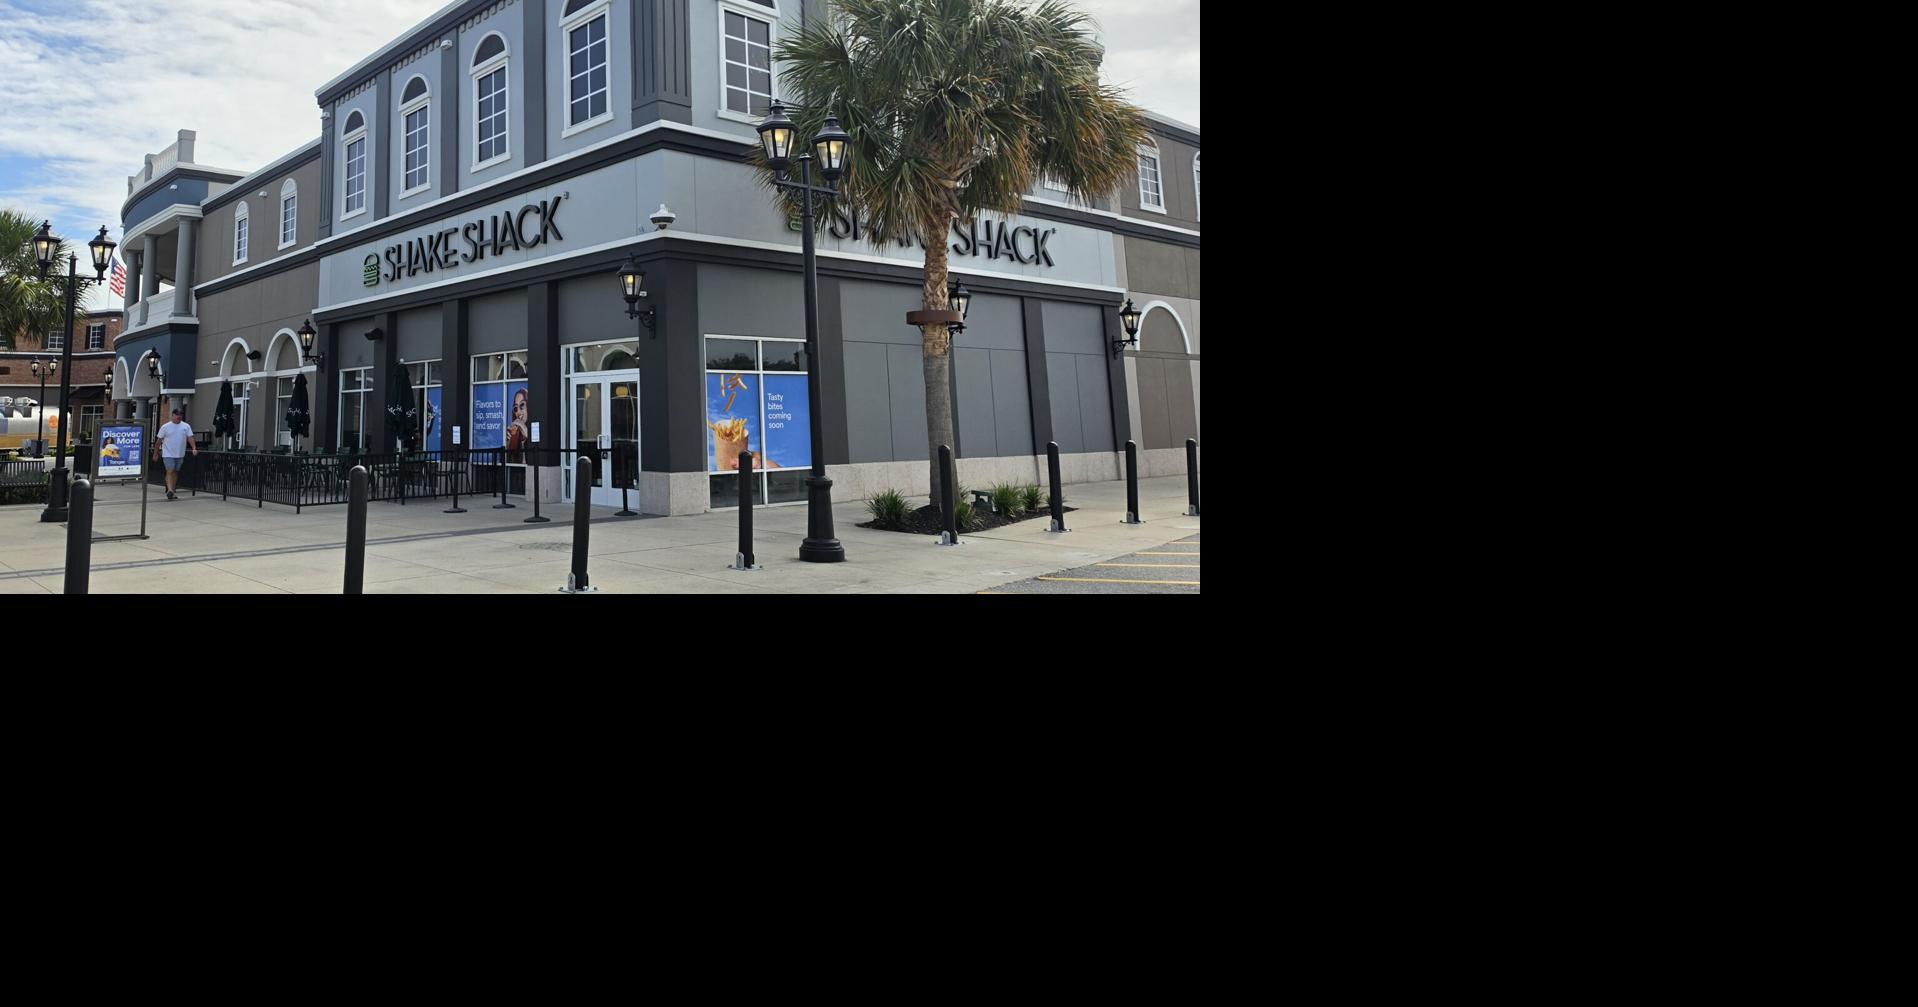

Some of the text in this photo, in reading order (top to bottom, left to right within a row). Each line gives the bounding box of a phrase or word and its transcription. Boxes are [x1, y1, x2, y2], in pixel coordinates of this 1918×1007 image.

[383, 196, 563, 282] SHAKE SHACK
[952, 217, 1055, 267] SHACK
[768, 393, 784, 402] Tasty
[475, 400, 502, 409] Flavors to
[768, 402, 783, 410] bites
[475, 410, 485, 421] sip,
[768, 411, 792, 421] coming
[768, 421, 784, 429] soon
[102, 430, 140, 438] Discover
[117, 437, 140, 445] More
